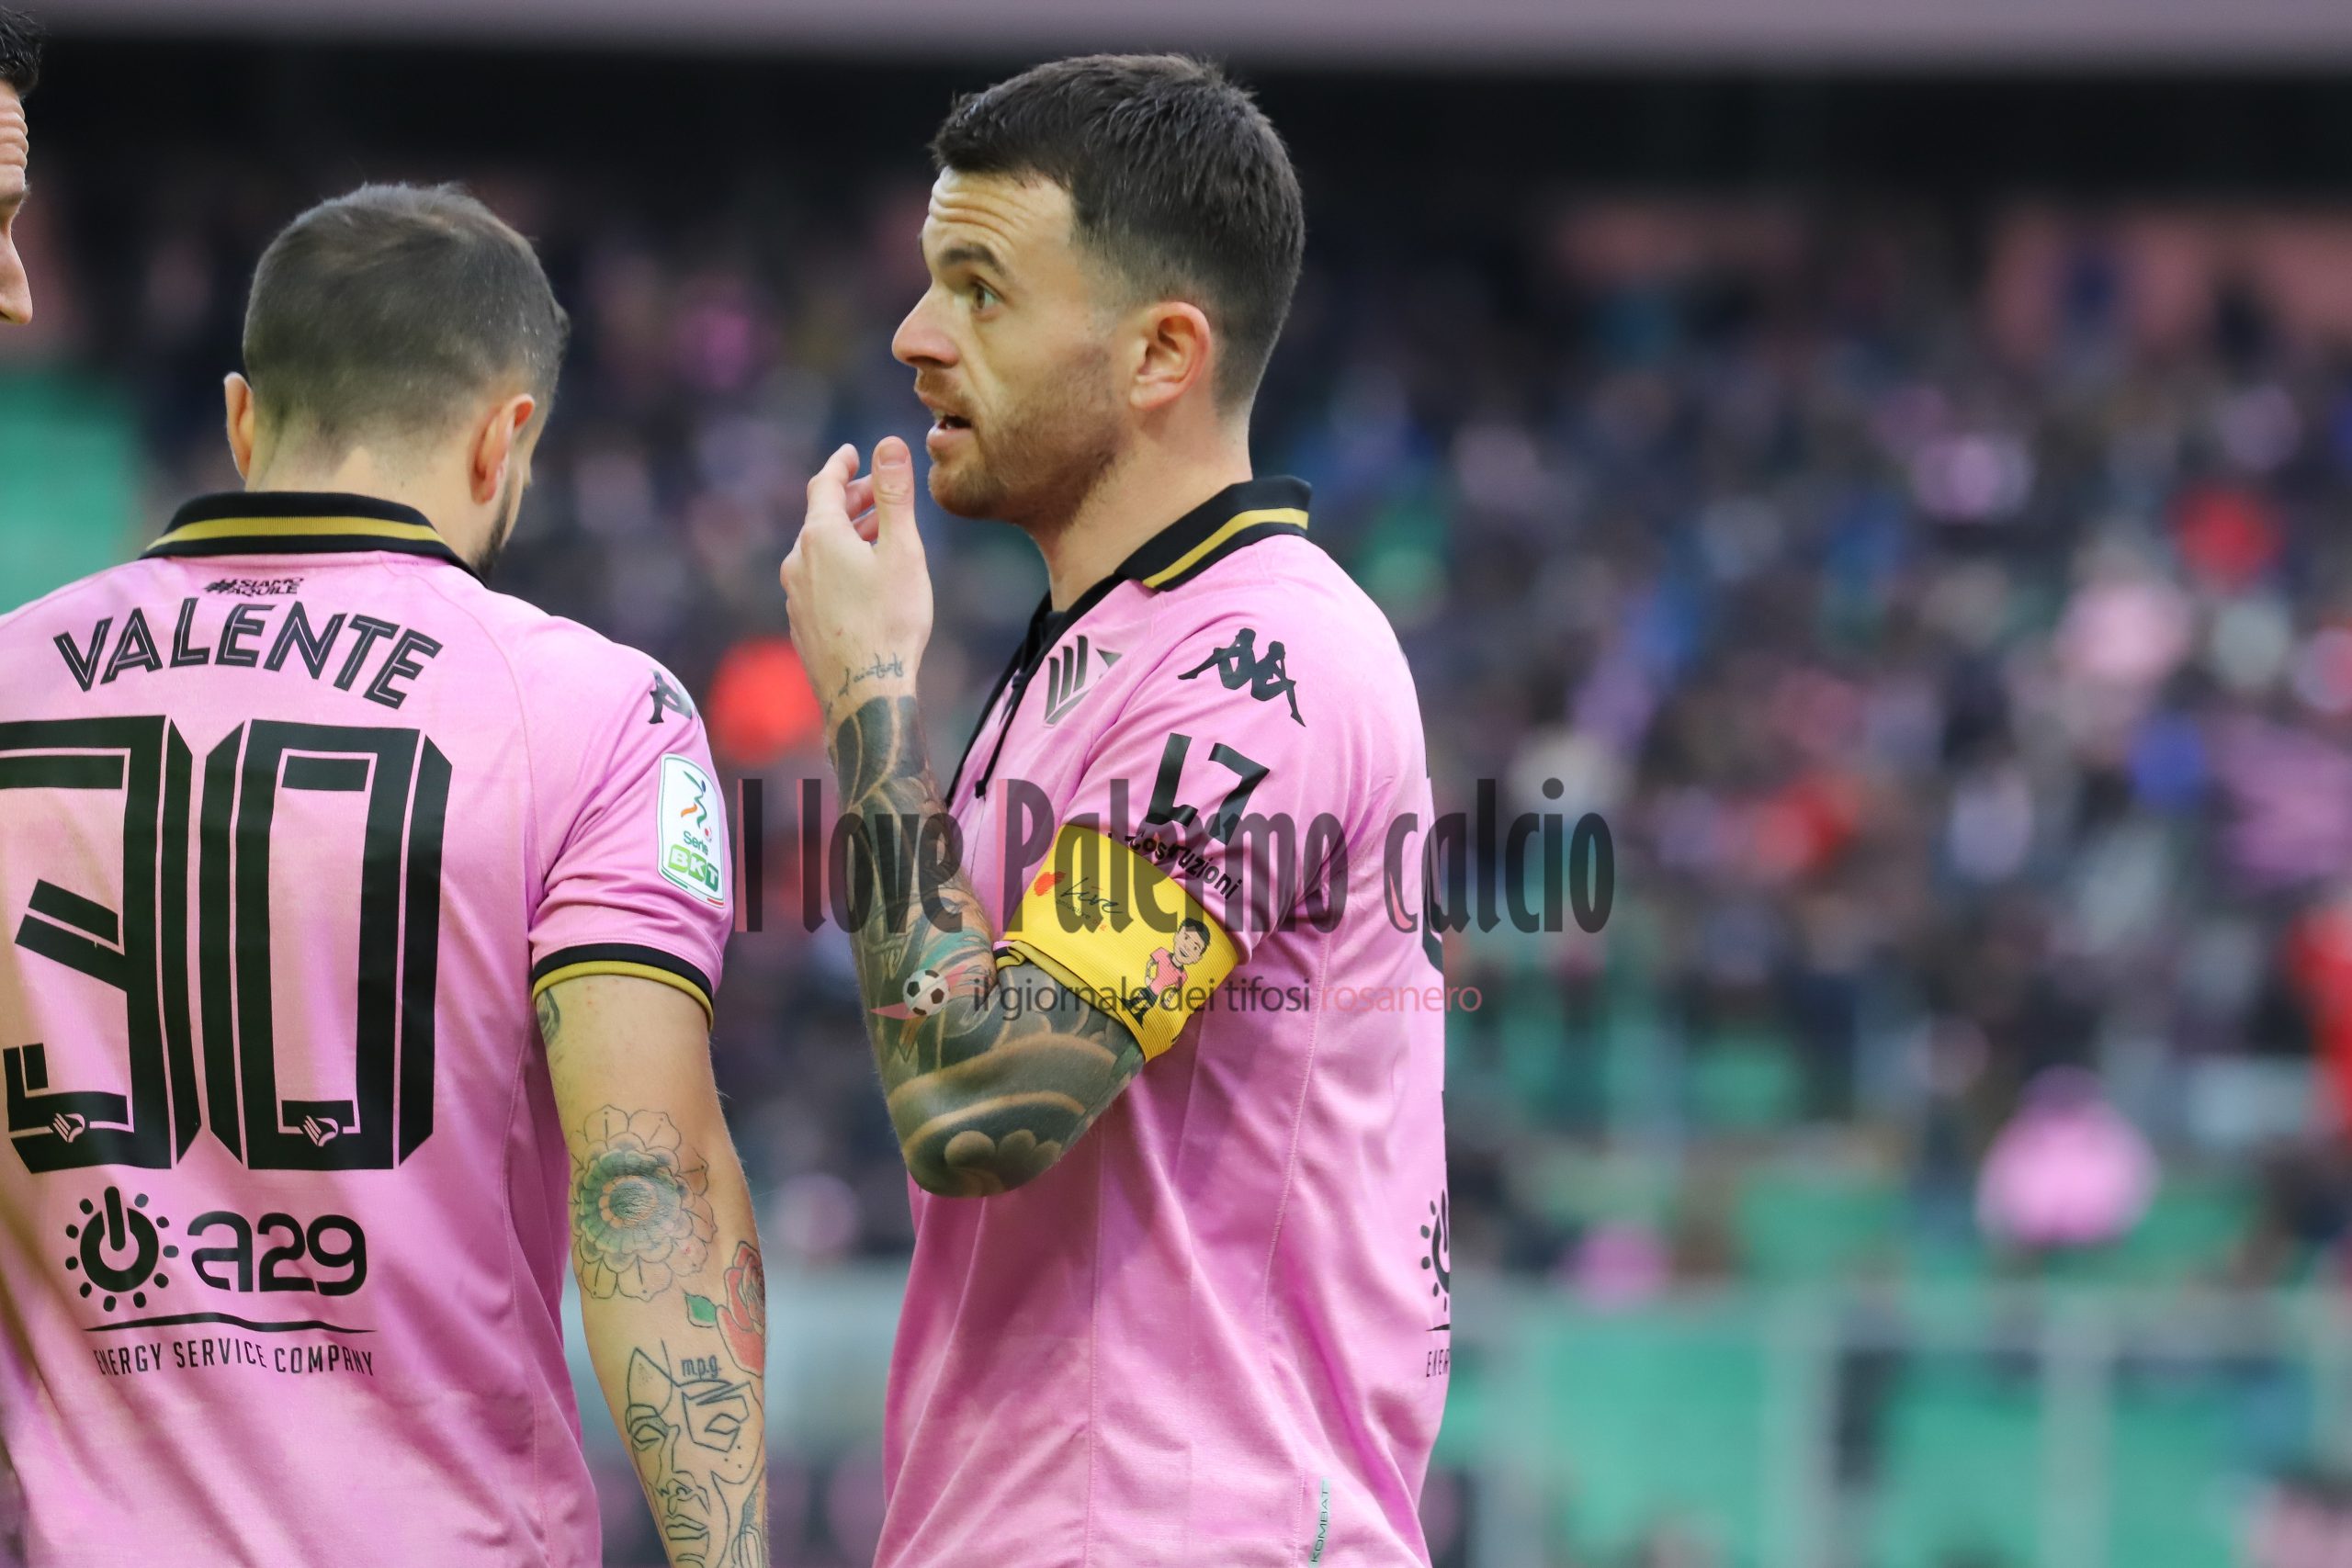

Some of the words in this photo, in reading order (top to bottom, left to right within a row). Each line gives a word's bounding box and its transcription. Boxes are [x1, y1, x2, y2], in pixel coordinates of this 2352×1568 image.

[52, 597, 443, 710] VALENTE
[668, 843, 719, 893] BKT
[683, 829, 709, 856] Serie
[0, 715, 453, 1174] 30
[187, 1211, 368, 1296] a29
[94, 1342, 162, 1376] ENERGY
[174, 1337, 267, 1369] SERVICE
[275, 1344, 374, 1376] COMPANY
[1311, 1491, 1329, 1562] KOMBAT
